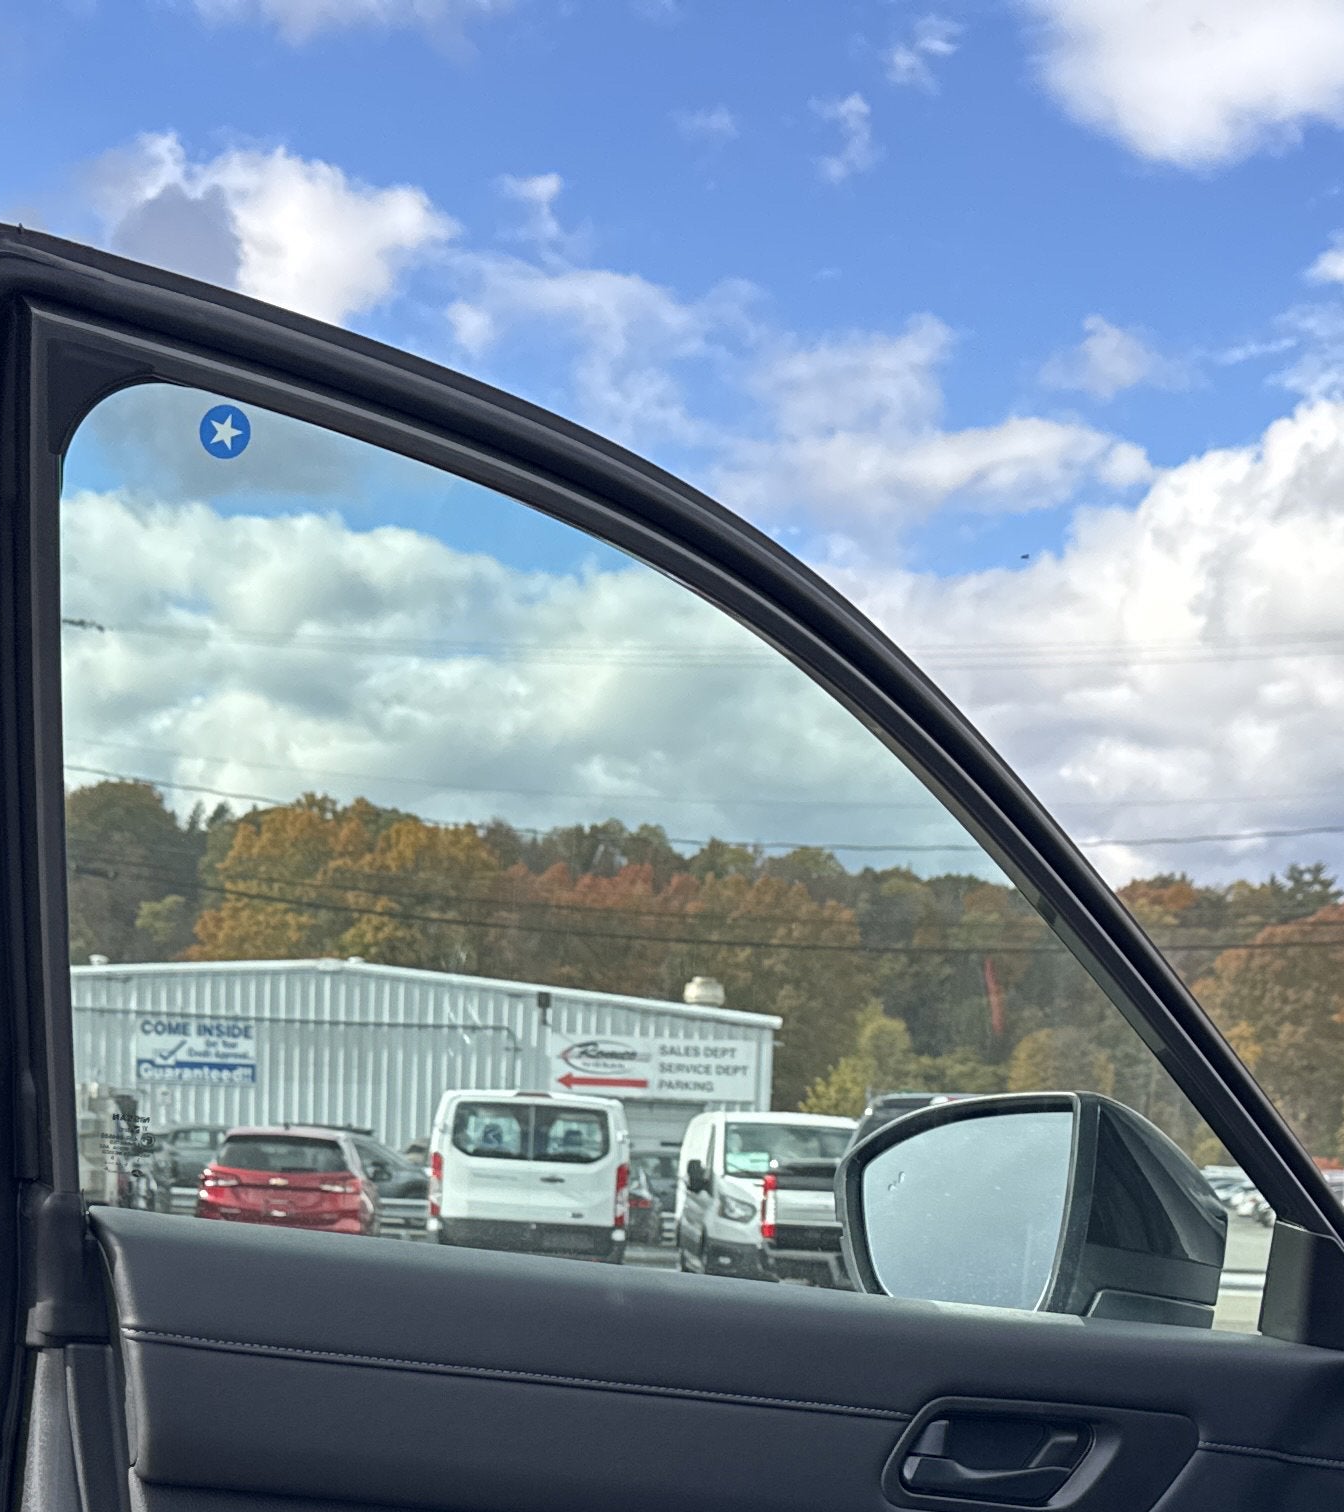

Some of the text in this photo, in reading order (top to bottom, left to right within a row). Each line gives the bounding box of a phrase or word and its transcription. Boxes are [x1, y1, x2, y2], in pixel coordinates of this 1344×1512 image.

[140, 1020, 253, 1039] COME INSIDE
[659, 1045, 738, 1059] SALES DEPT
[659, 1062, 749, 1077] SERVICE DEPT
[659, 1080, 714, 1092] PARKING
